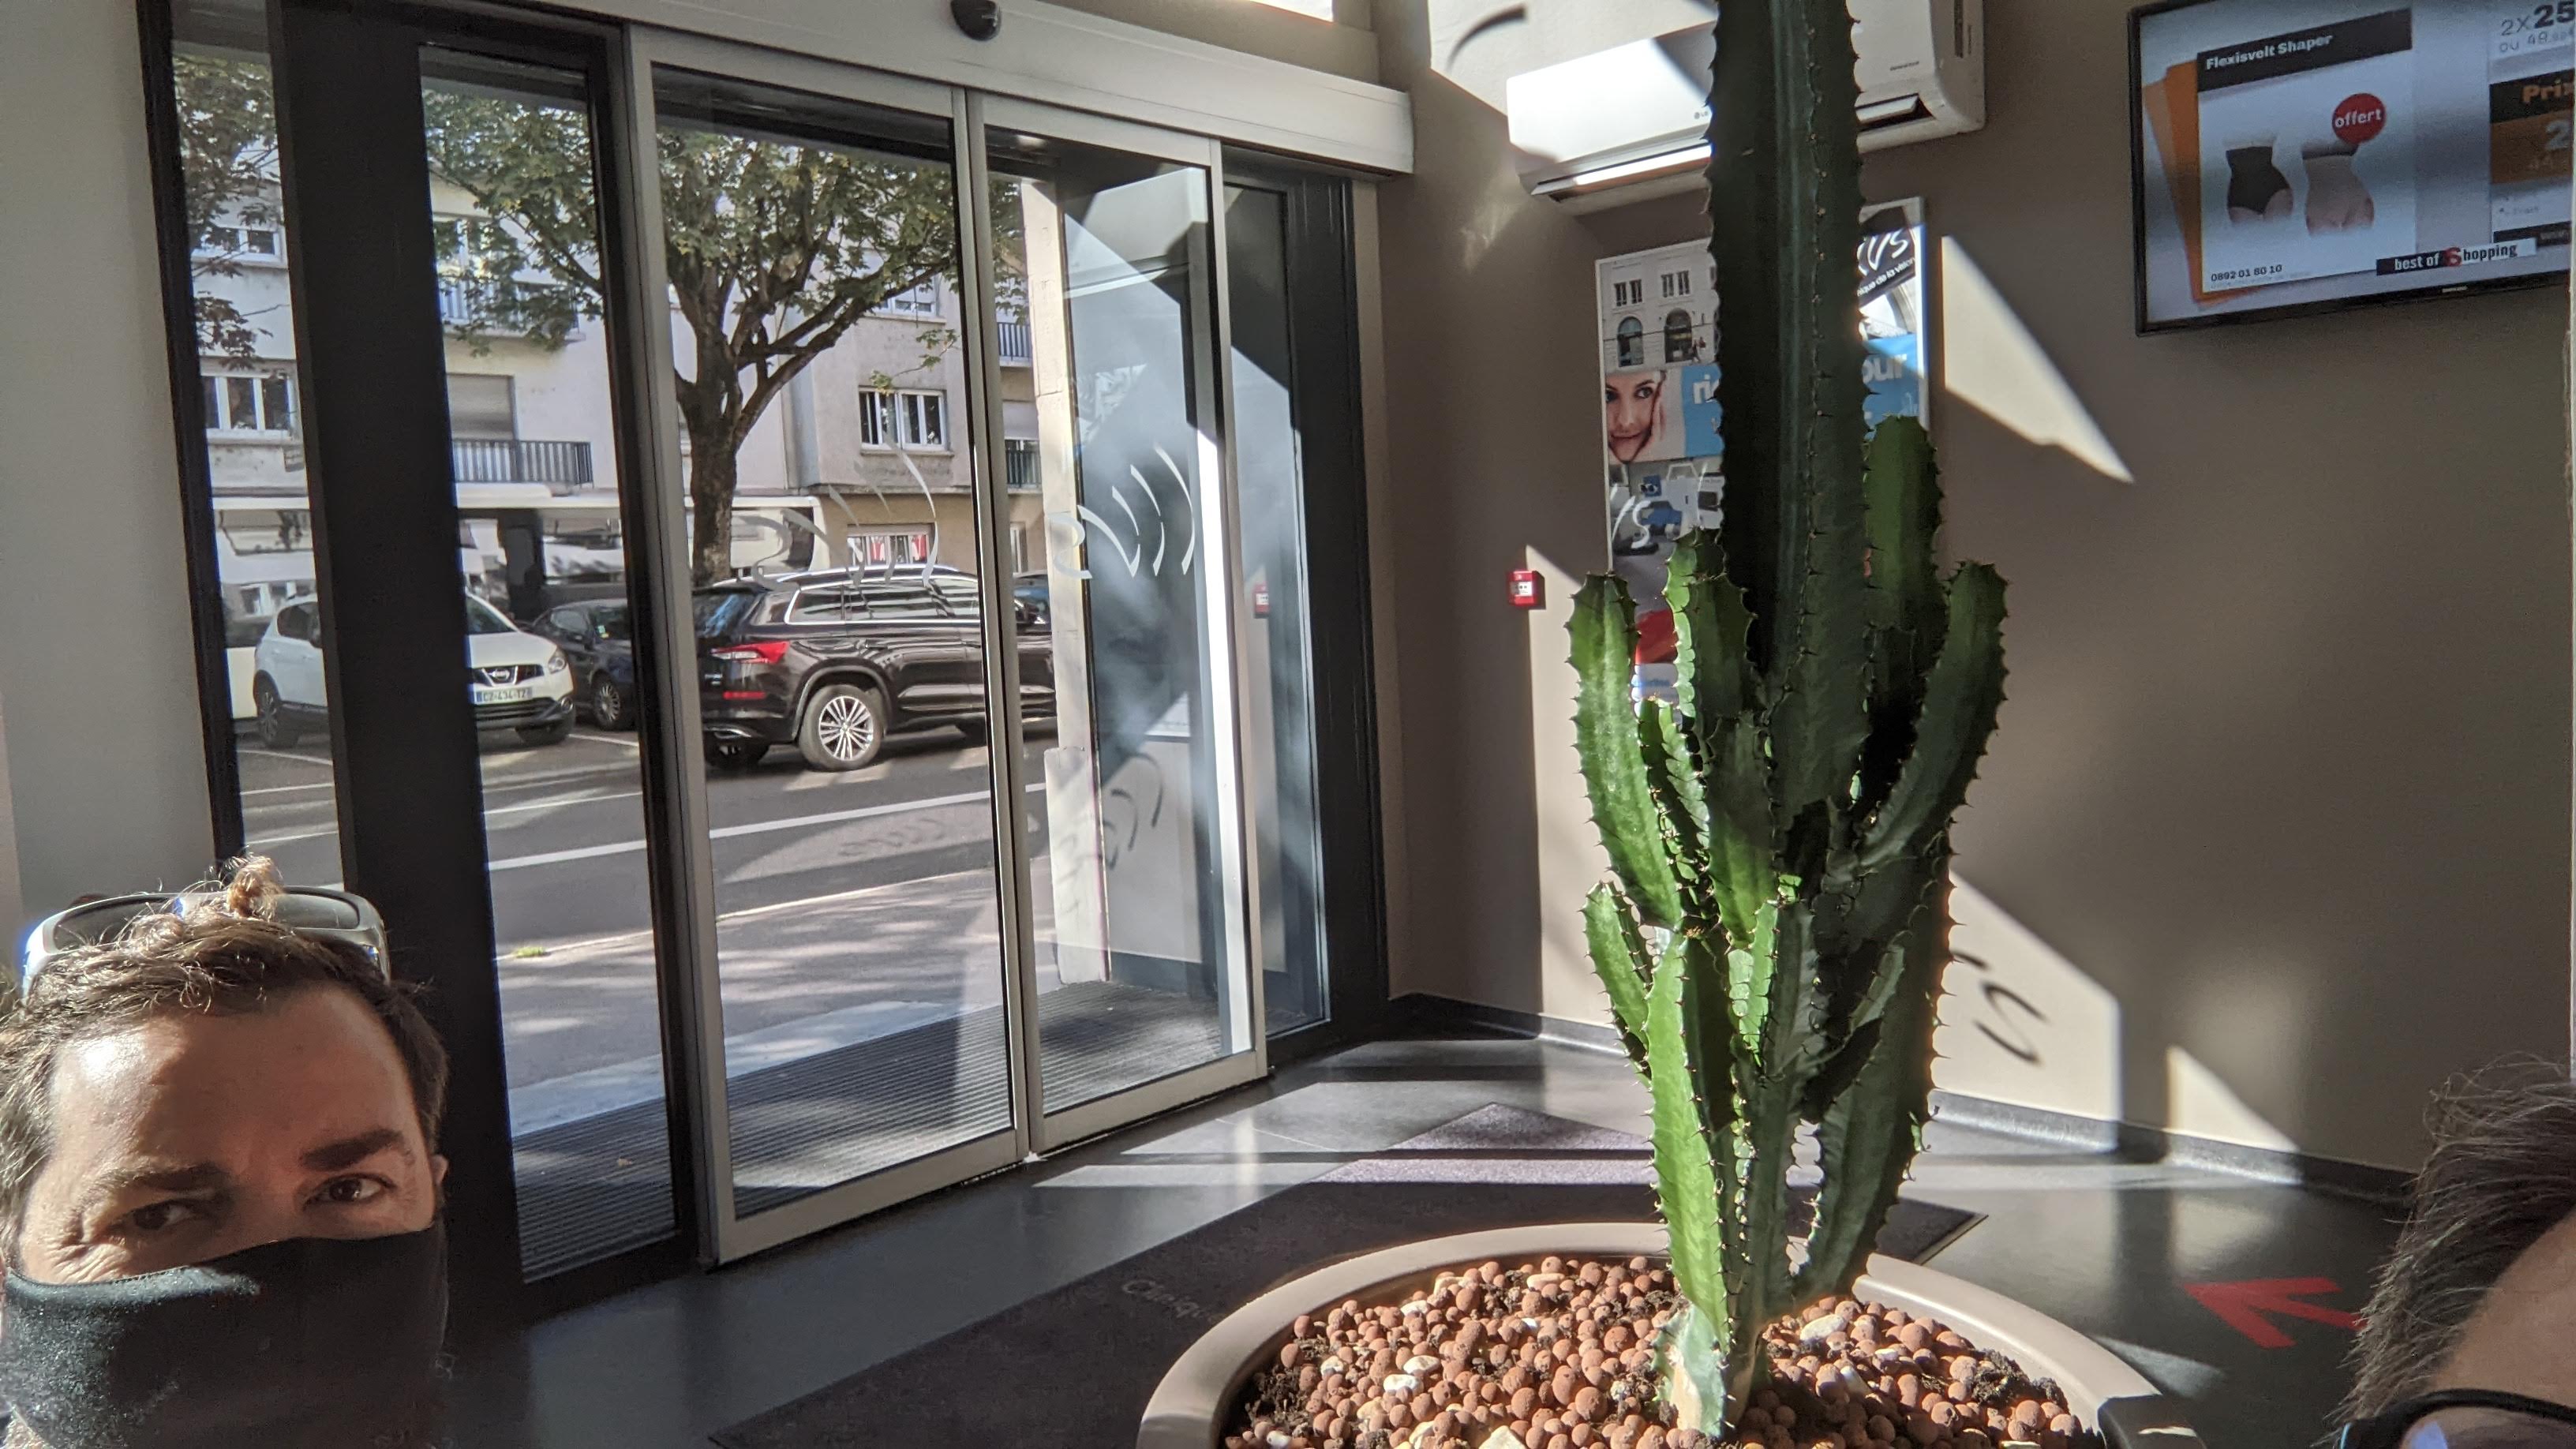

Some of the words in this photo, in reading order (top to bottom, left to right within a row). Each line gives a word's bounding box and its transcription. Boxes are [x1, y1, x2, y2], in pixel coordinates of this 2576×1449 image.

[2206, 45, 2275, 70] Flexisvelt
[2278, 35, 2334, 55] Shaper
[2334, 108, 2382, 129] offert
[2394, 253, 2422, 271] best
[2426, 252, 2440, 267] of
[2211, 271, 2237, 282] 0892
[2238, 269, 2251, 278] 01
[2269, 264, 2282, 274] 10
